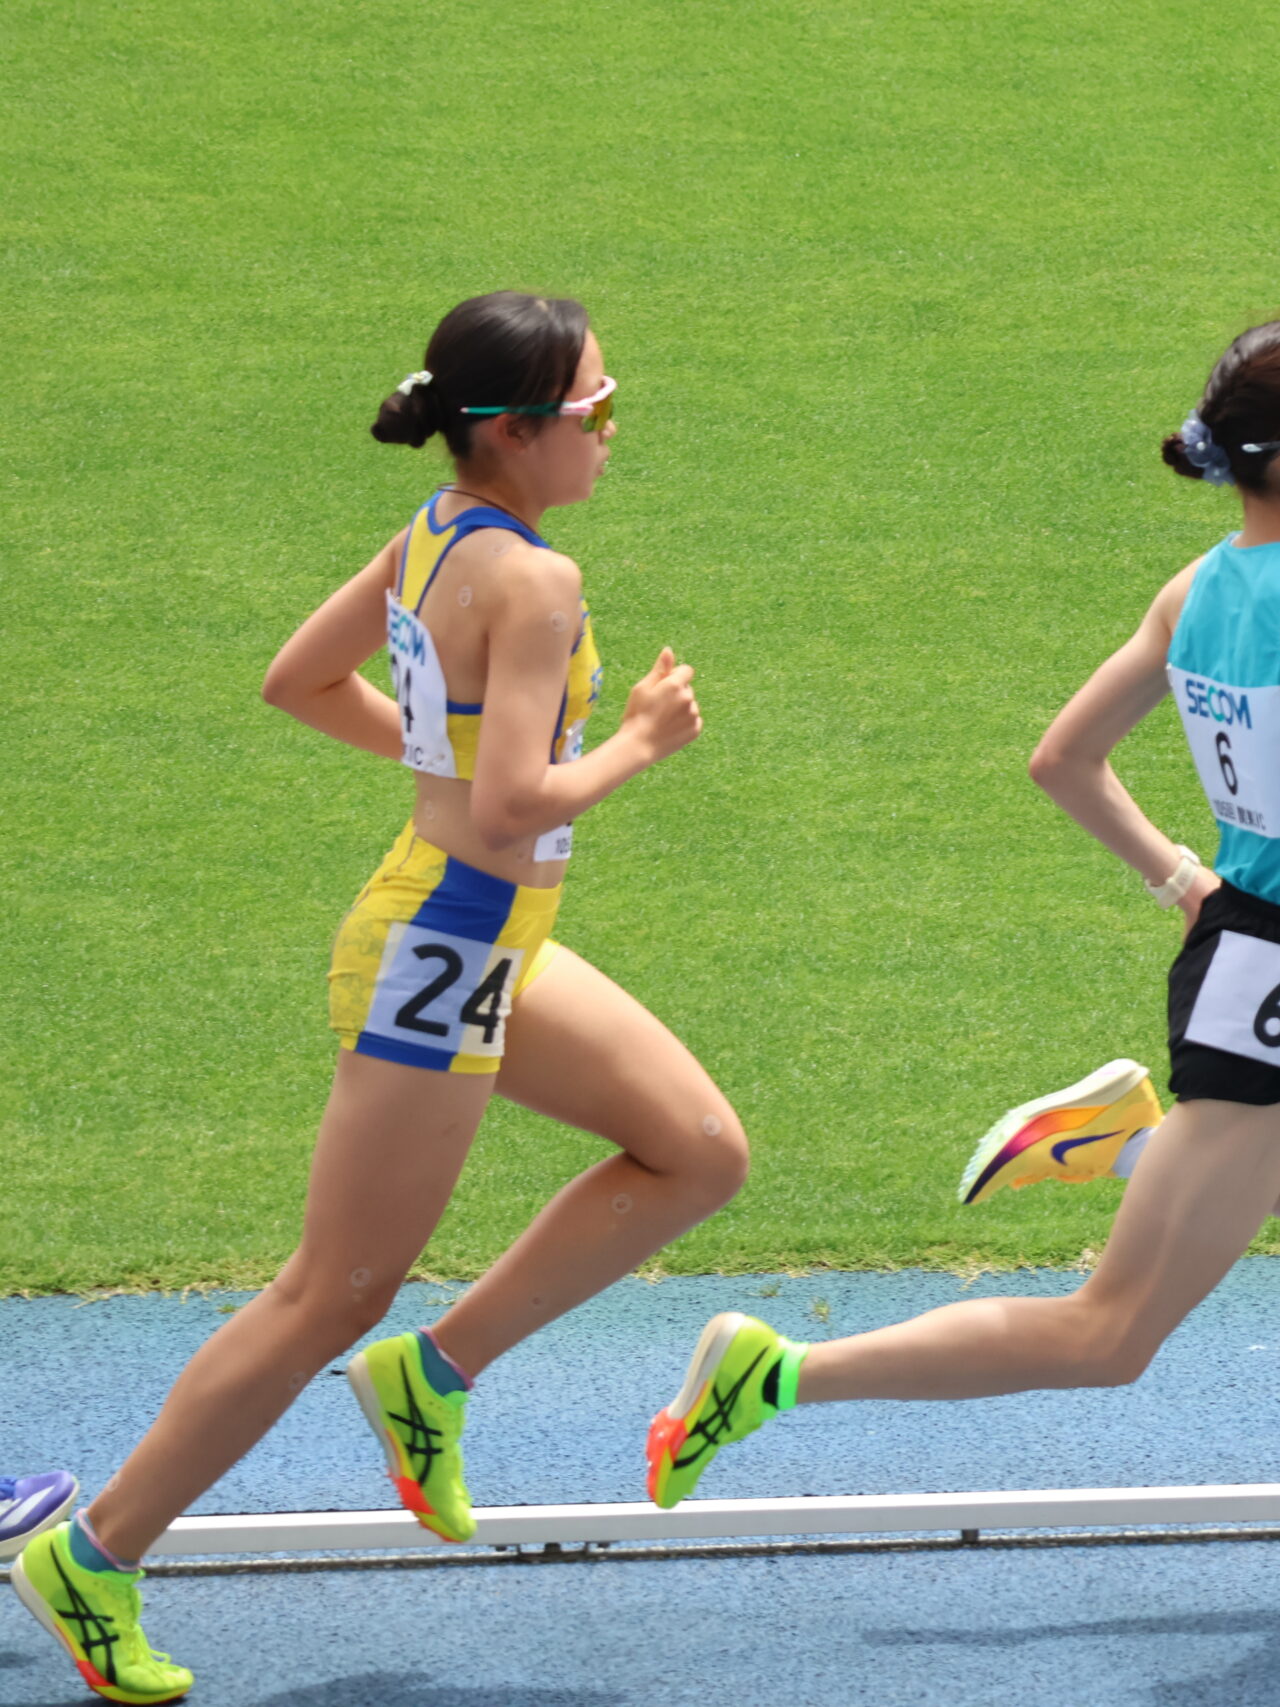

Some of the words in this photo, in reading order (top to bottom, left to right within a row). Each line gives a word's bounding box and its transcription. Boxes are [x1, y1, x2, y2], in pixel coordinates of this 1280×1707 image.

[1185, 678, 1252, 730] SECOM
[1214, 731, 1239, 796] 6
[394, 943, 512, 1044] 24
